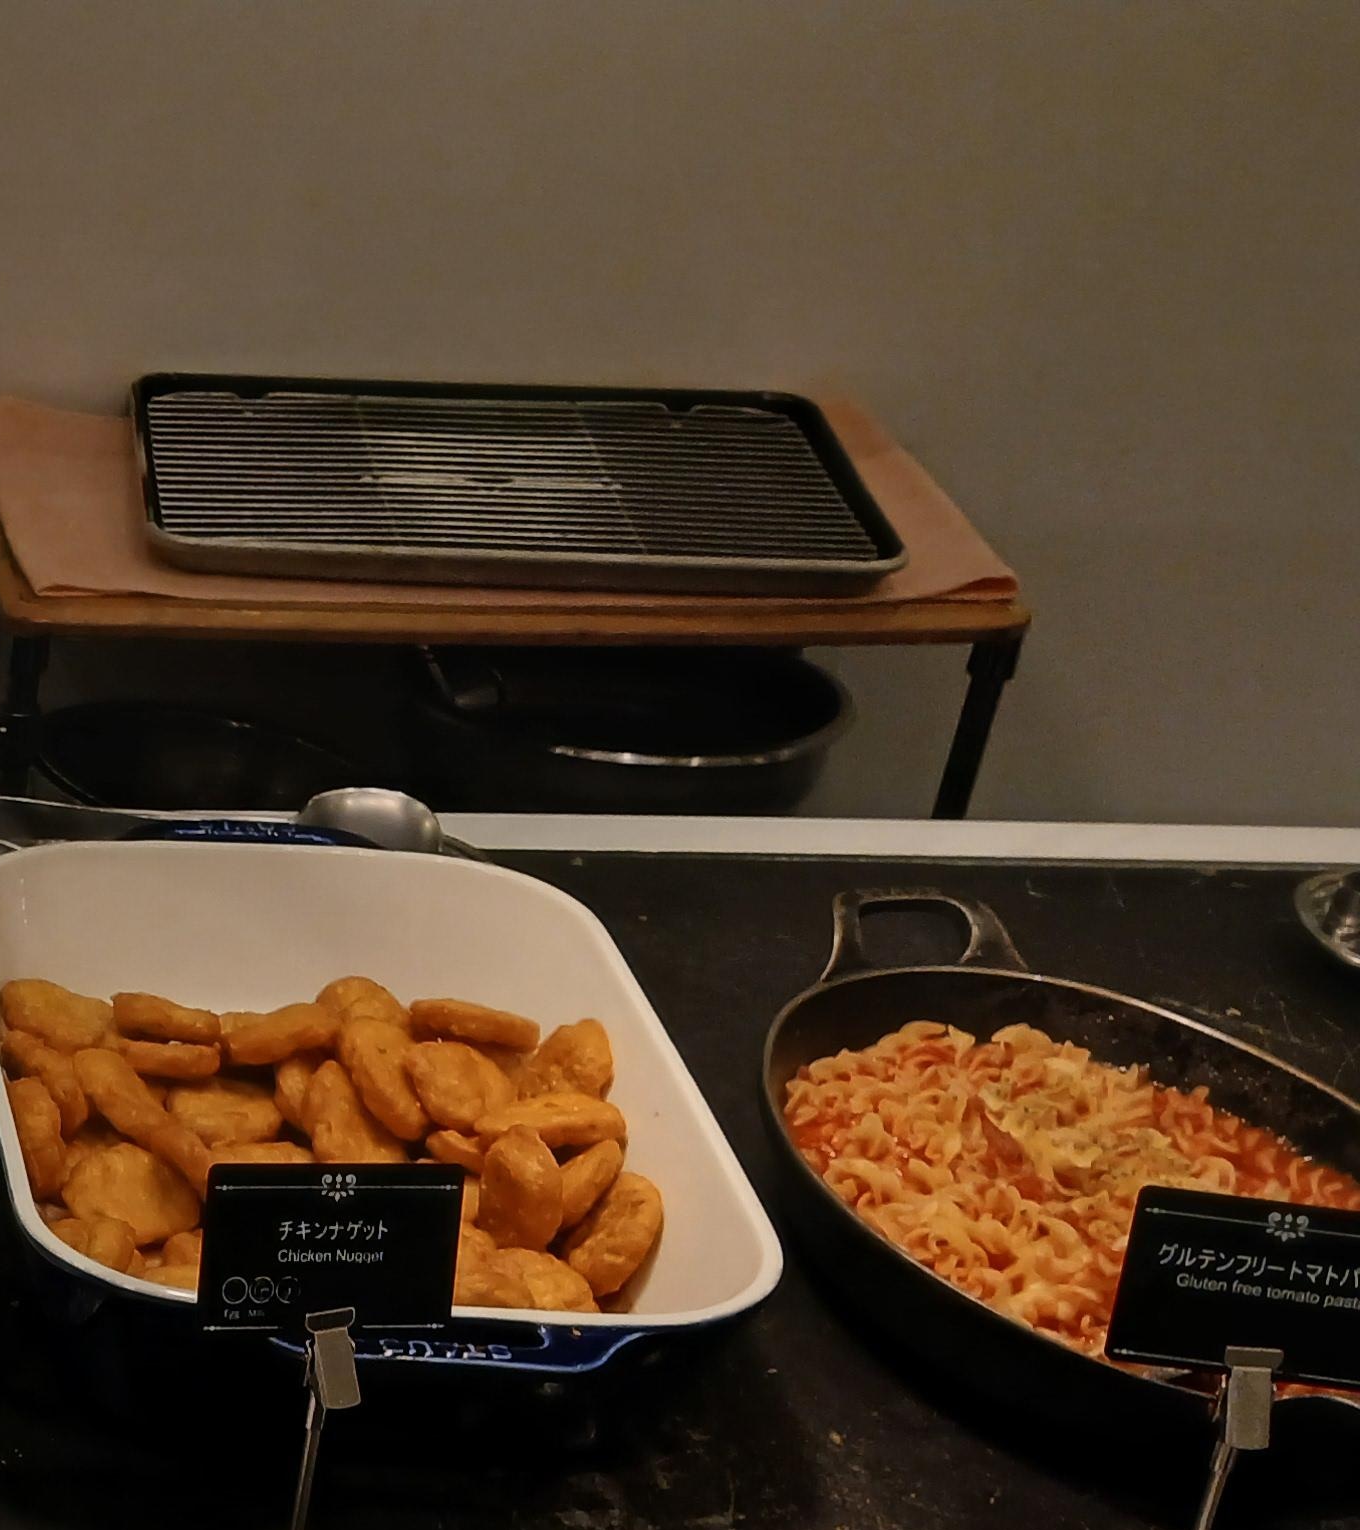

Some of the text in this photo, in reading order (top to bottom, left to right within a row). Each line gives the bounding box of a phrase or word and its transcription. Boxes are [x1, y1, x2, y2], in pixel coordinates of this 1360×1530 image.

[278, 1219, 389, 1241] チキンナゲット
[277, 1249, 384, 1264] Chicken Nugget
[1176, 1272, 1228, 1292] Gluten
[1232, 1281, 1262, 1297] free
[1266, 1286, 1321, 1305] tomato
